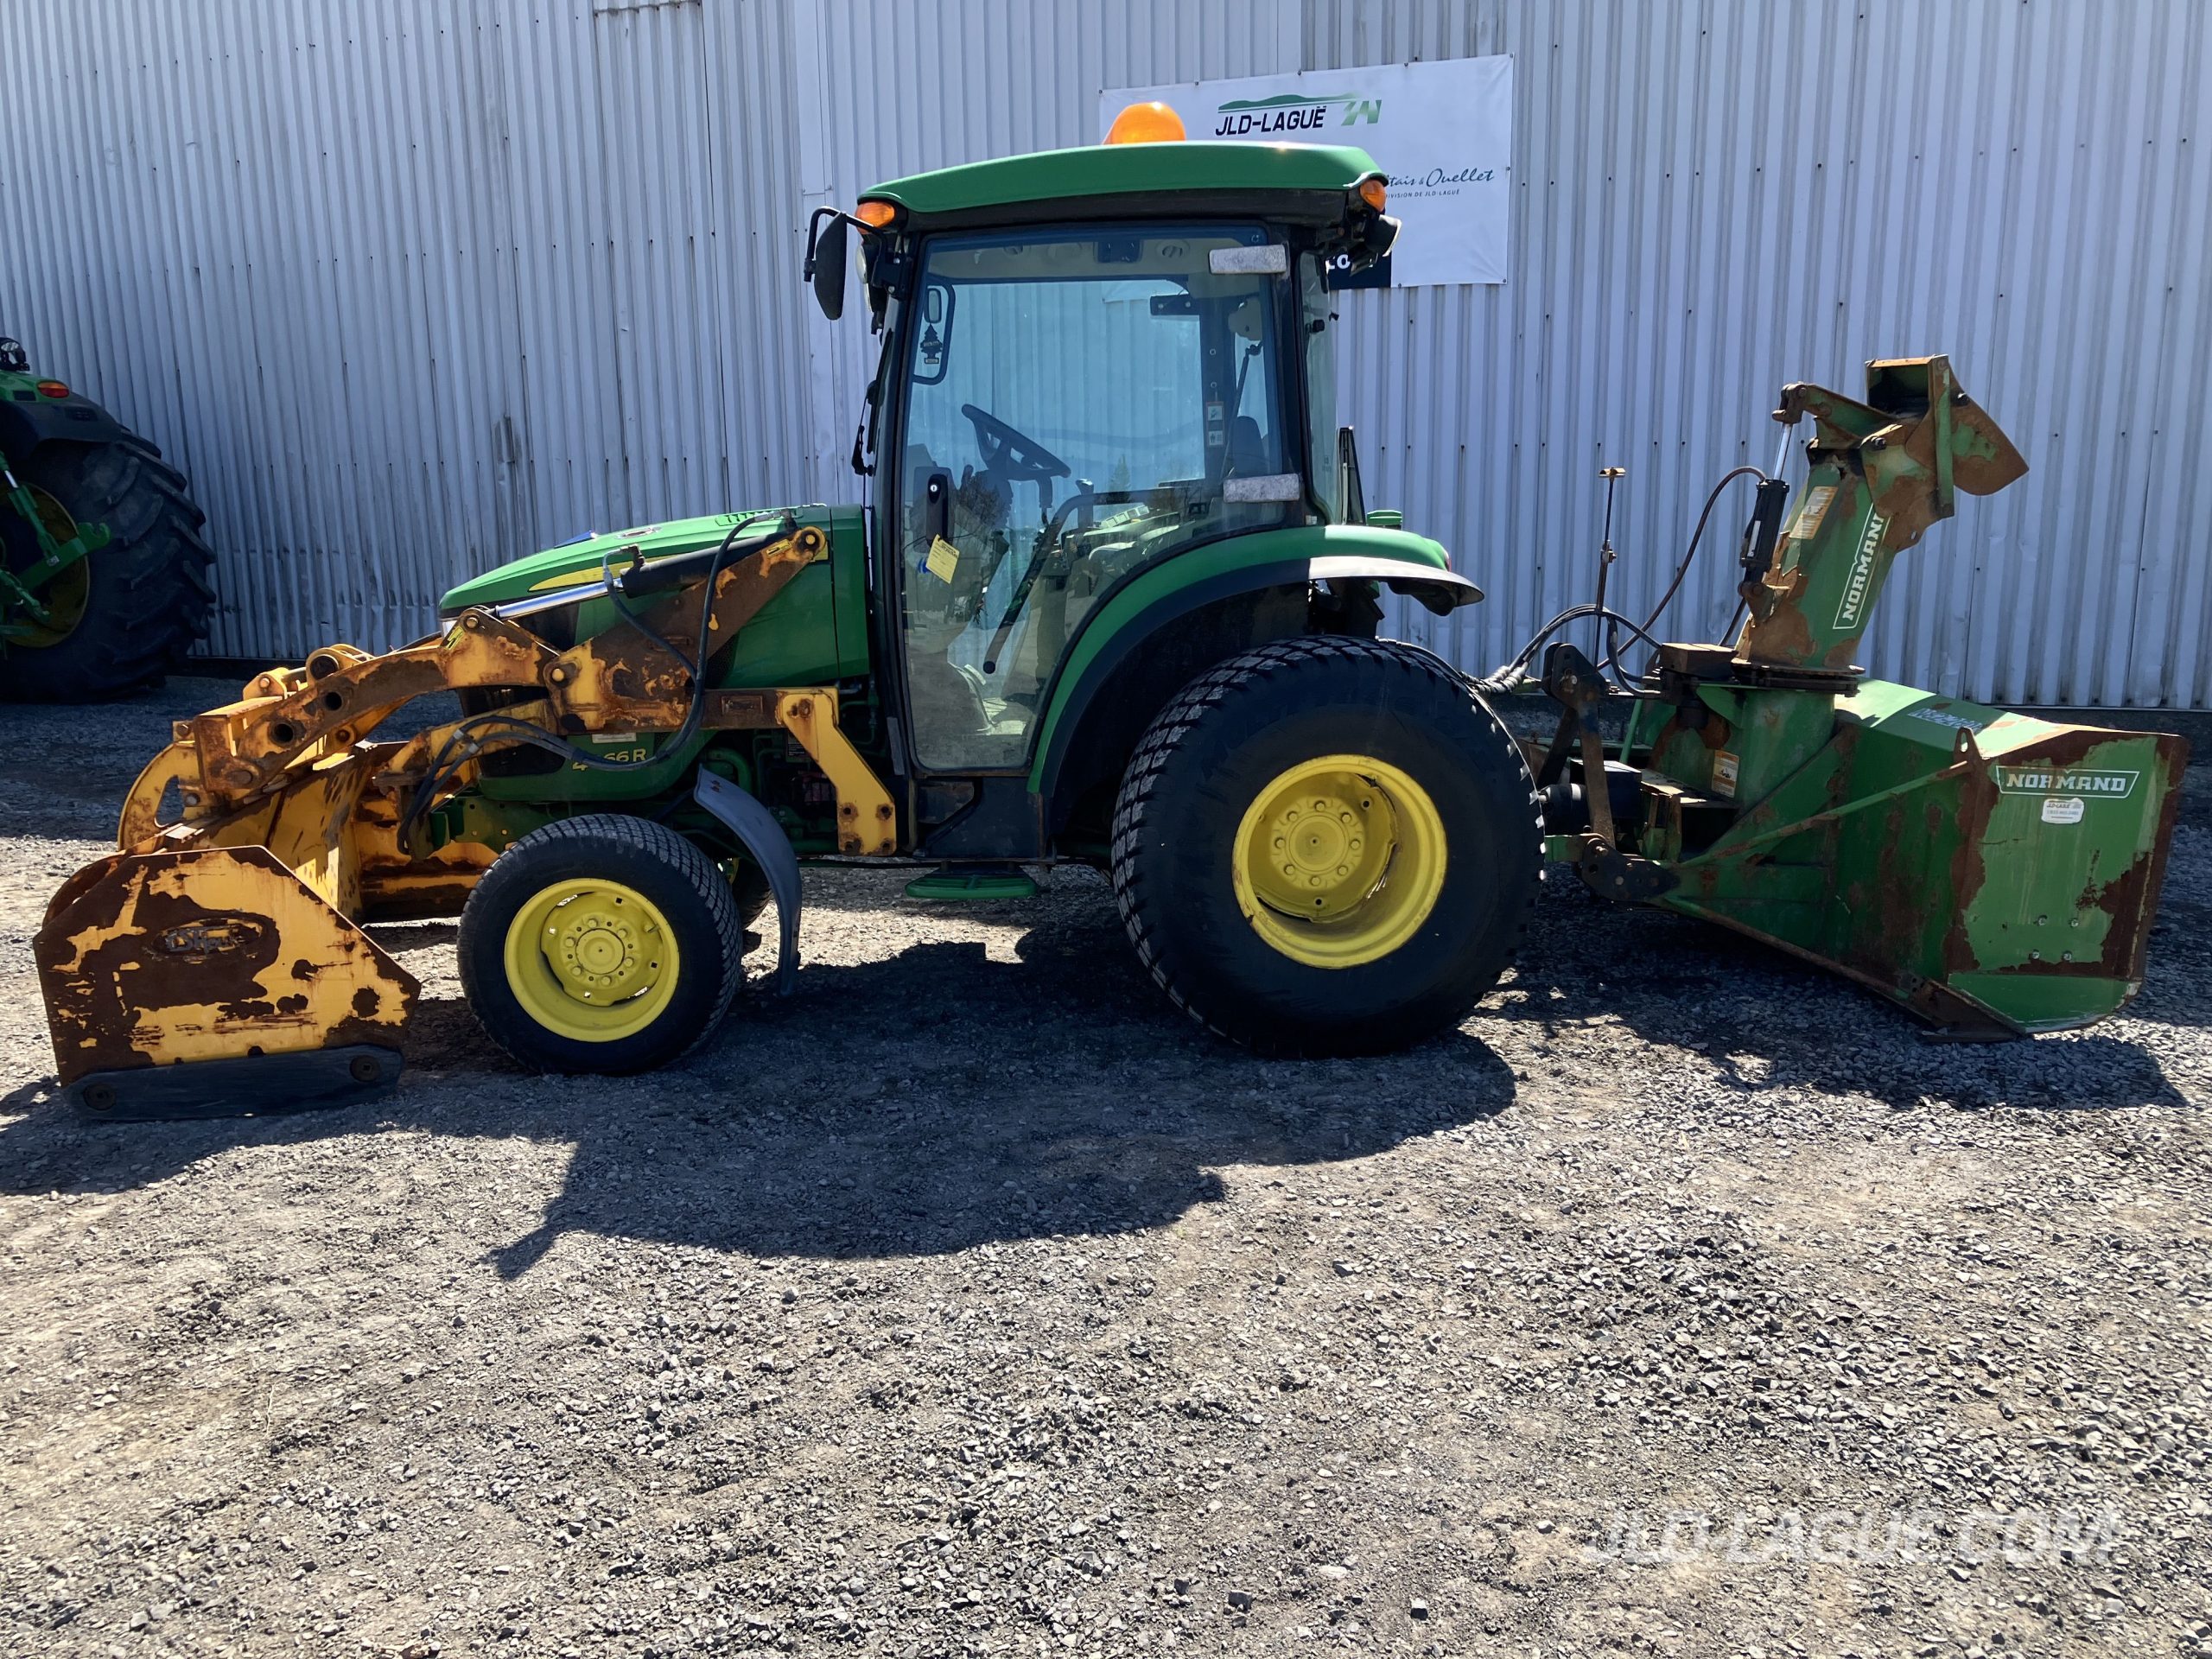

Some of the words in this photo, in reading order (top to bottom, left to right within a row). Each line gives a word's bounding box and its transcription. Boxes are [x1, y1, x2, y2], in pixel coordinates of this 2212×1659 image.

[1215, 105, 1327, 137] JLD-LAGUË
[1387, 175, 1415, 188] tais
[1426, 167, 1495, 188] Ouellet
[2005, 773, 2126, 792] NORMAND
